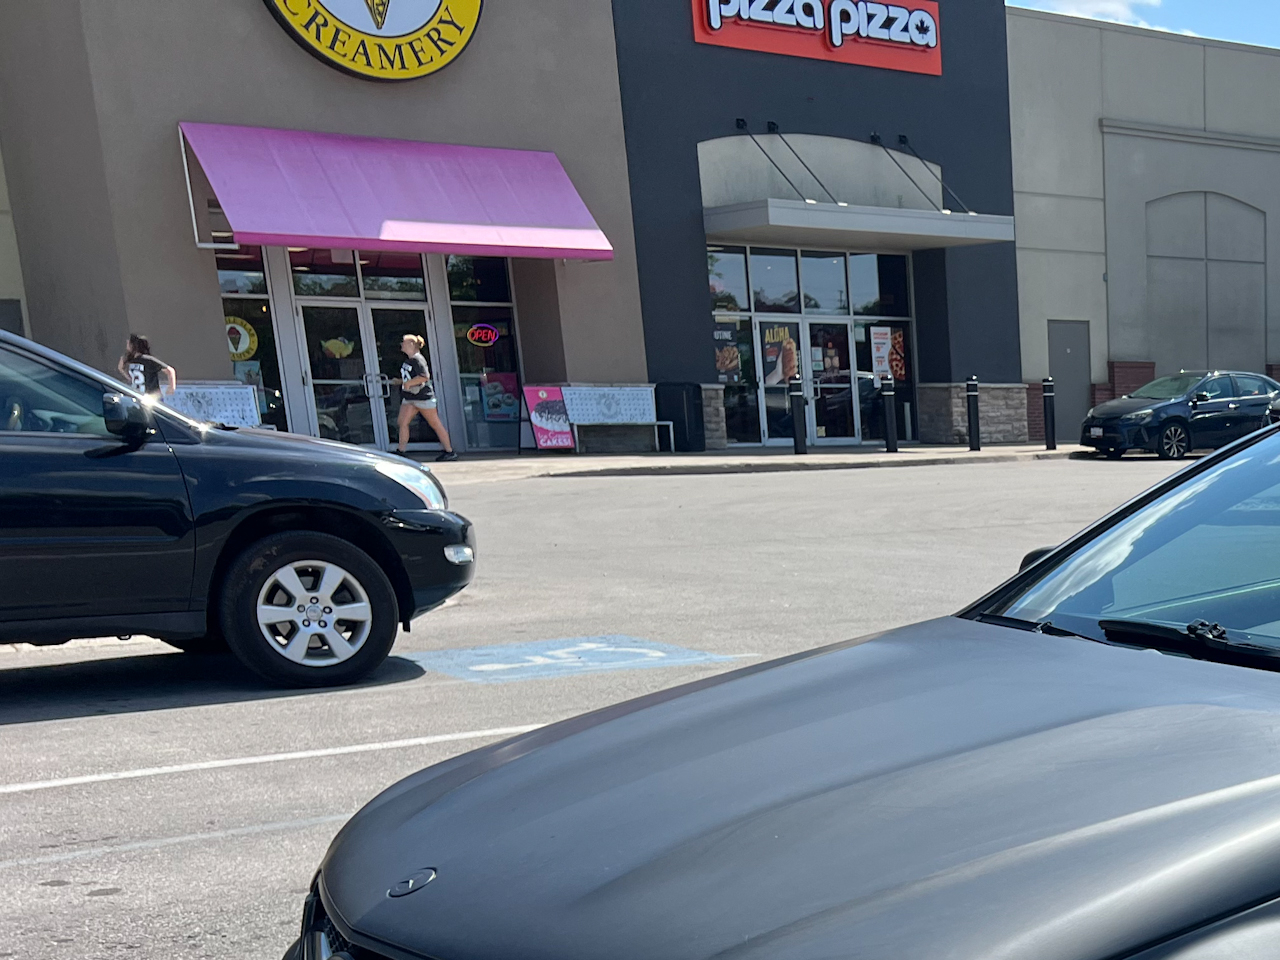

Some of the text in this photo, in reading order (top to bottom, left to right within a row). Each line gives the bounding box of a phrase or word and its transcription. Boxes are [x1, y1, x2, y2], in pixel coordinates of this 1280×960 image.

[708, 0, 938, 47] pizza pizza
[469, 329, 496, 342] OPEN
[765, 326, 790, 343] ALOHA
